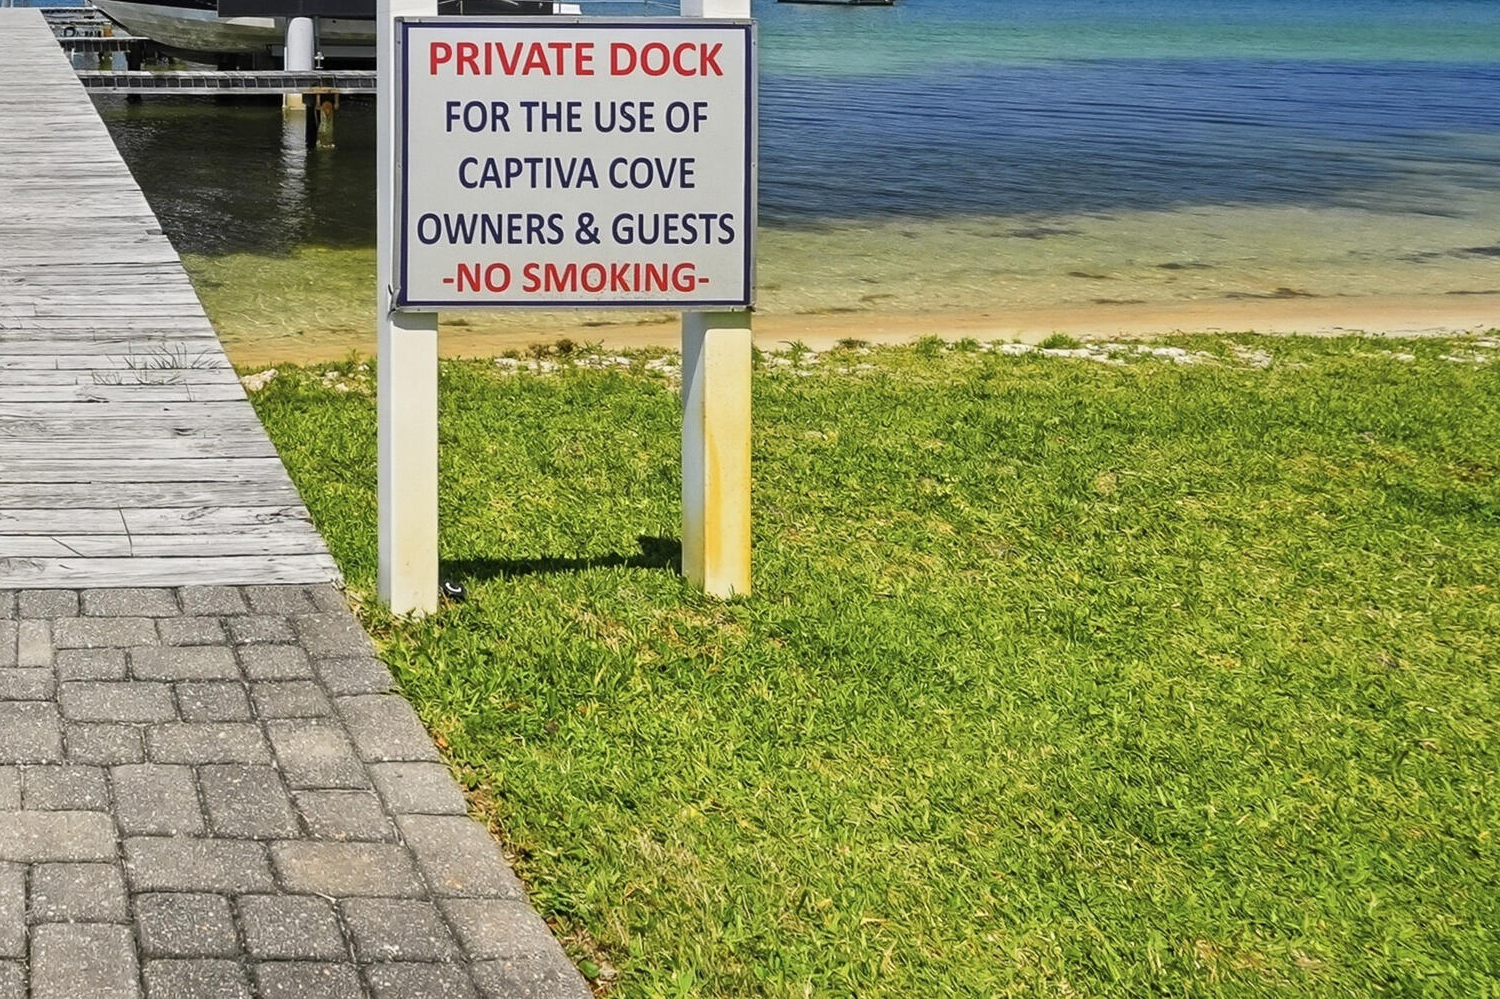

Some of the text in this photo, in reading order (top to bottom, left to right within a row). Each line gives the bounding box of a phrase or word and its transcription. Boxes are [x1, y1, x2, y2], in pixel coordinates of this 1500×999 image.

[430, 41, 724, 77] PRIVATE DOCK
[446, 100, 709, 134] FOR THE USE OF
[458, 156, 696, 190] CAPTIVA COVE
[417, 211, 735, 245] OWNERS & GUESTS
[442, 262, 710, 293] -NO SMOKING-
